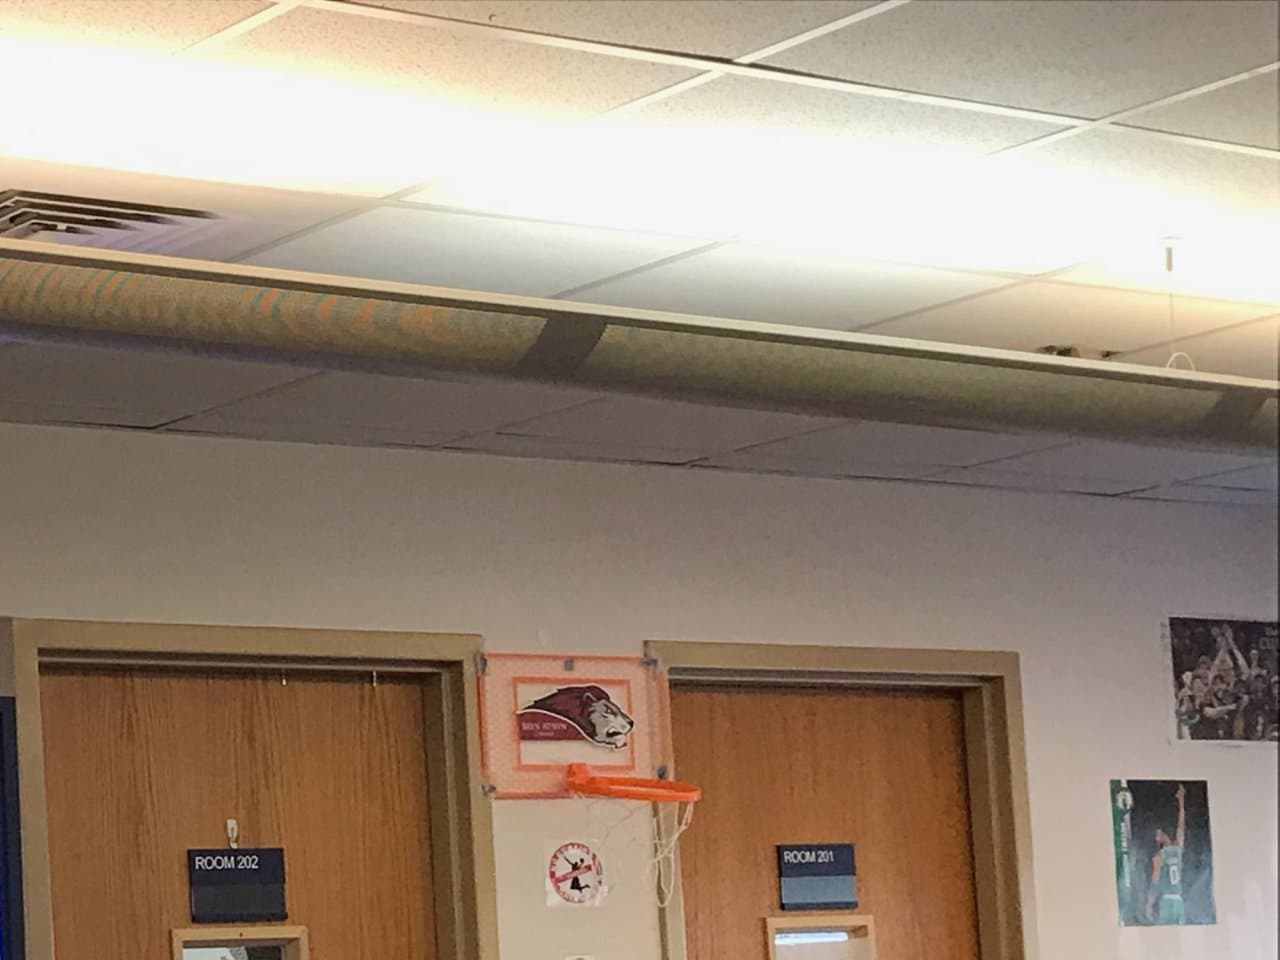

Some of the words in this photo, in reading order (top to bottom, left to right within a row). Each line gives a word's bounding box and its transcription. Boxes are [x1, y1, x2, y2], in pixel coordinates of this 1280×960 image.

[195, 856, 236, 870] ROOM
[237, 855, 260, 869] 202
[783, 851, 816, 863] ROOM
[817, 850, 835, 862] 201
